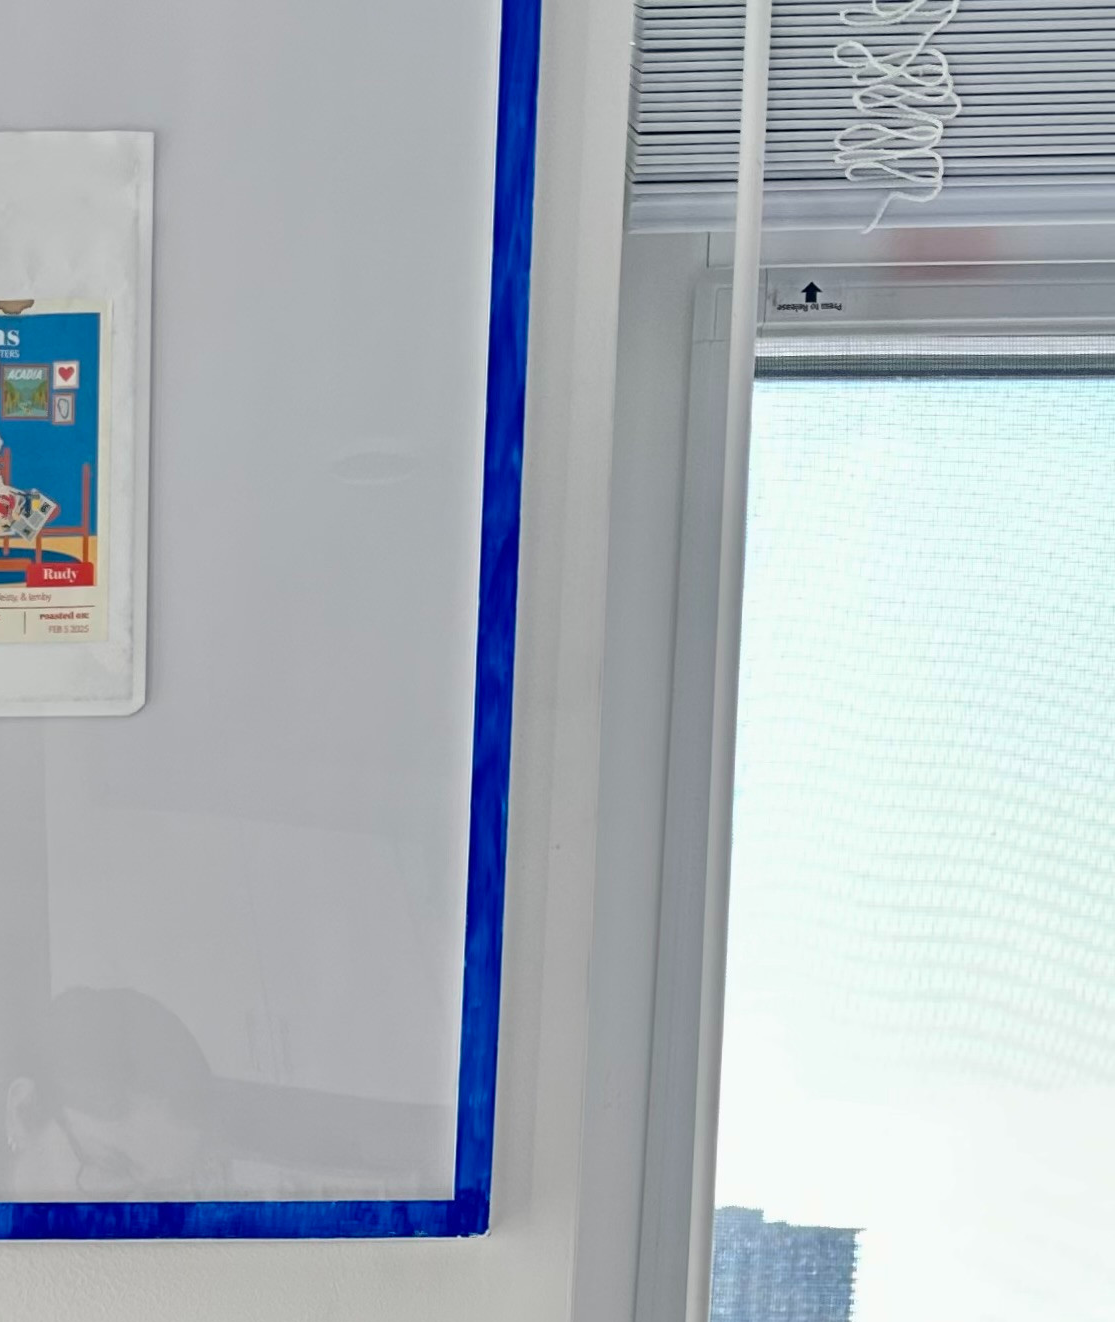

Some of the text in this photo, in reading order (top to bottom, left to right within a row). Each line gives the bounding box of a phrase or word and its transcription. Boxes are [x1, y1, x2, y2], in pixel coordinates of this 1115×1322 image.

[777, 303, 808, 312] Release
[821, 303, 842, 311] Press
[7, 369, 43, 380] ACADIA
[43, 568, 78, 583] Rudy
[20, 592, 27, 601] &
[39, 611, 74, 620] roasted
[48, 625, 62, 634] FEB
